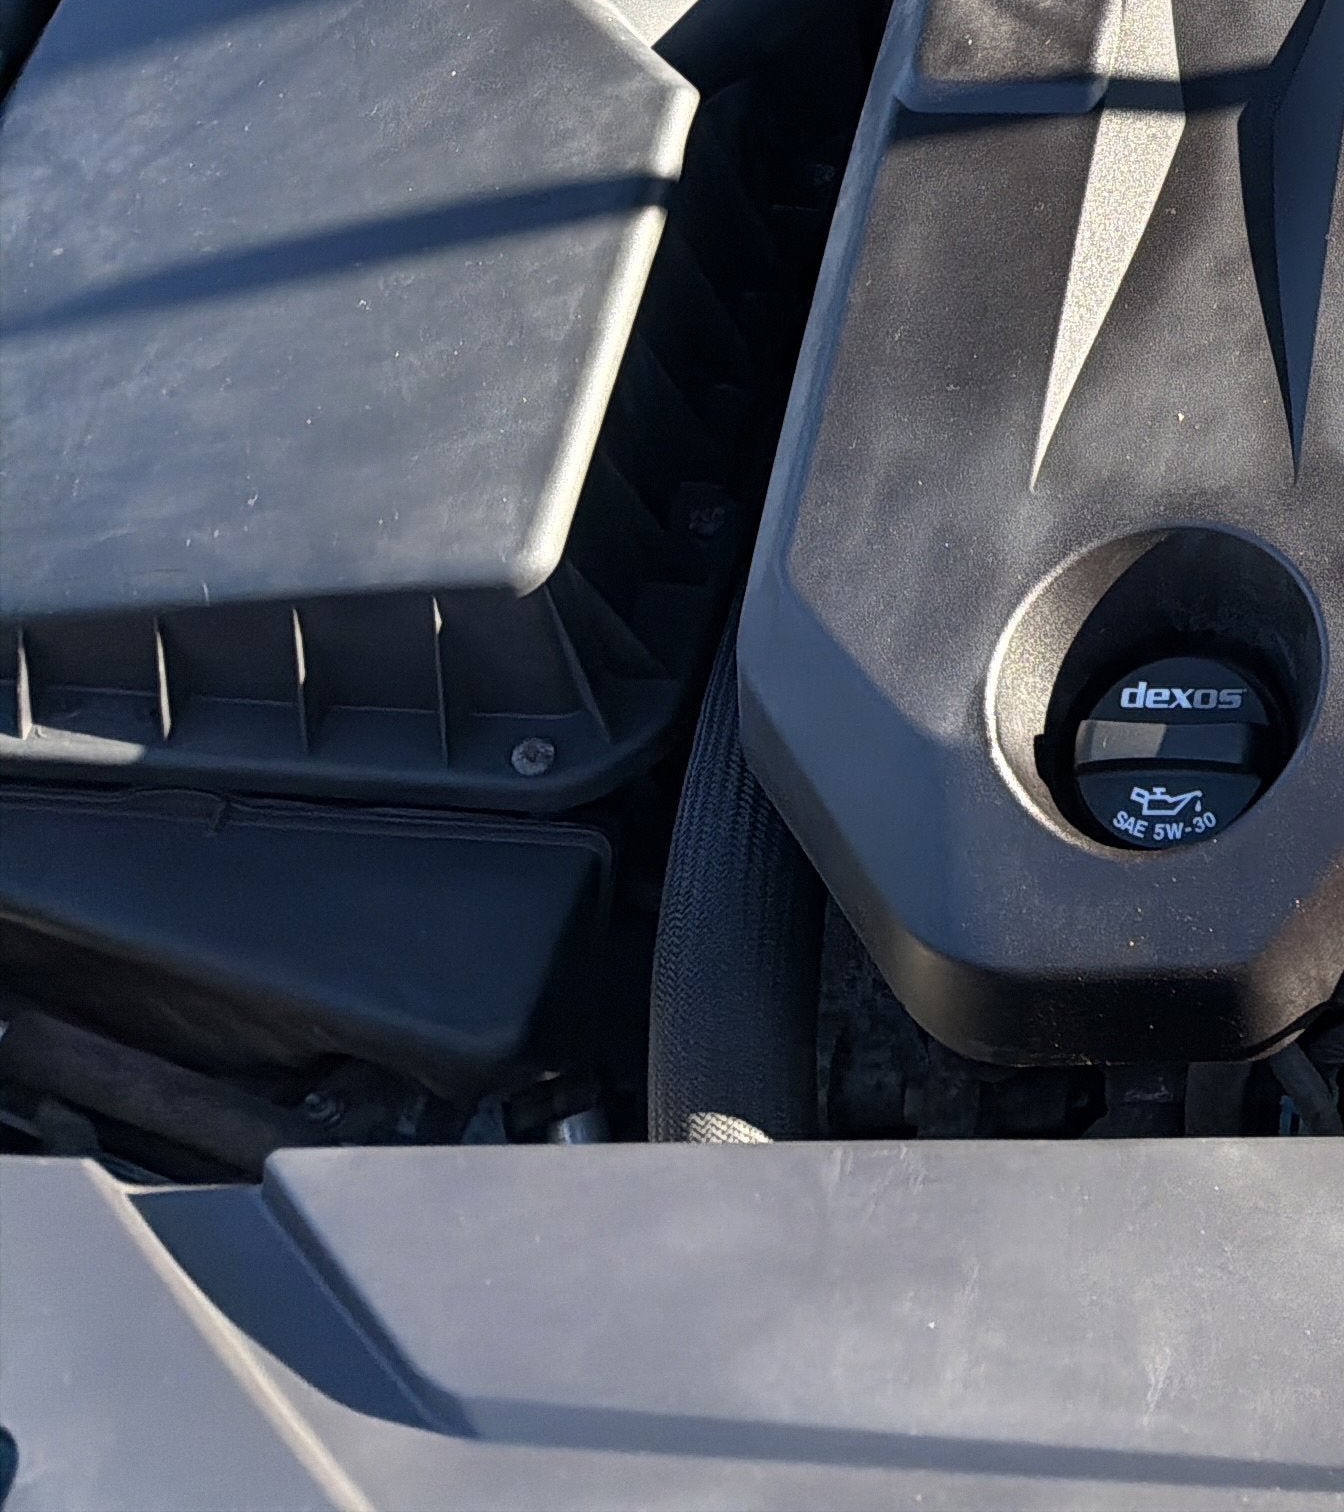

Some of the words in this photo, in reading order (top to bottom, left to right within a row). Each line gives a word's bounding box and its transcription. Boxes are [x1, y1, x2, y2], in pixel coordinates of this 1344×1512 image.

[1120, 681, 1243, 709] dexos
[1112, 810, 1149, 839] SAE
[1152, 811, 1217, 841] 5W-30
